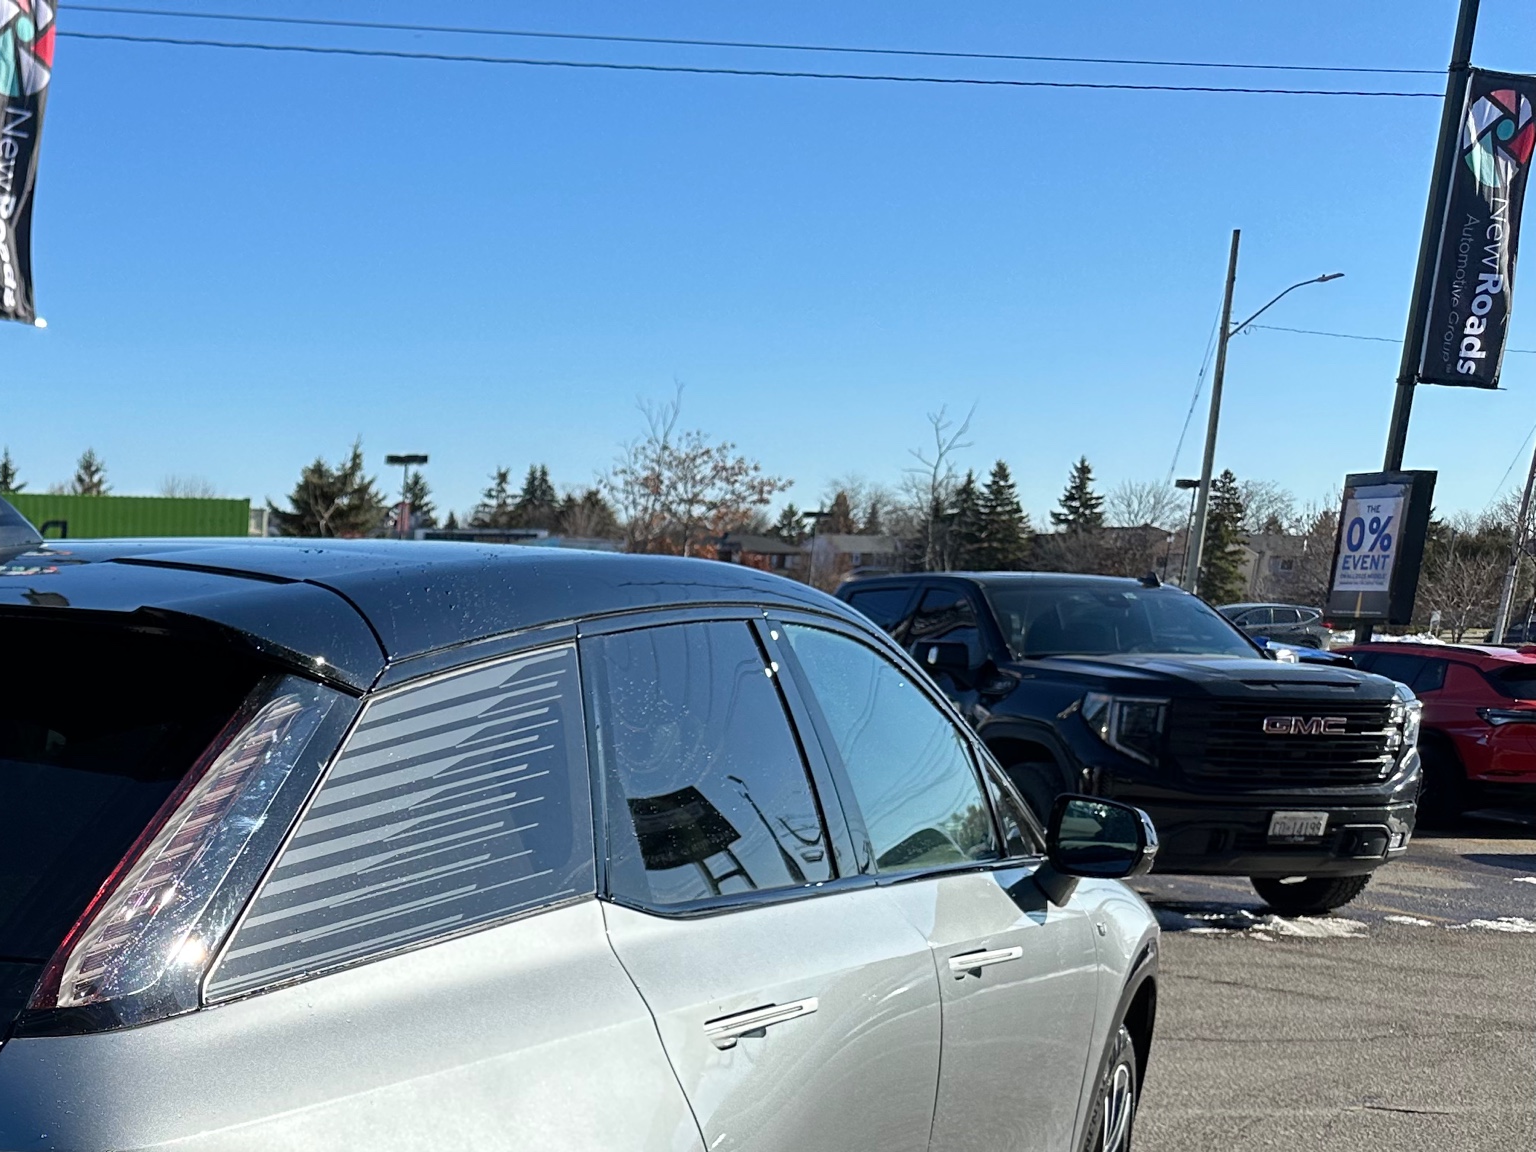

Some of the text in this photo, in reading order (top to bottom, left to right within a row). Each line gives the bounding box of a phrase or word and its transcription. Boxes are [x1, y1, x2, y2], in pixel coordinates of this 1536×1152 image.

[1450, 212, 1481, 307] Automotive
[1456, 197, 1510, 376] NewRoads
[1367, 505, 1382, 513] THE
[1346, 515, 1394, 553] 0%
[1341, 554, 1390, 571] EVENT
[1262, 716, 1348, 735] GMC
